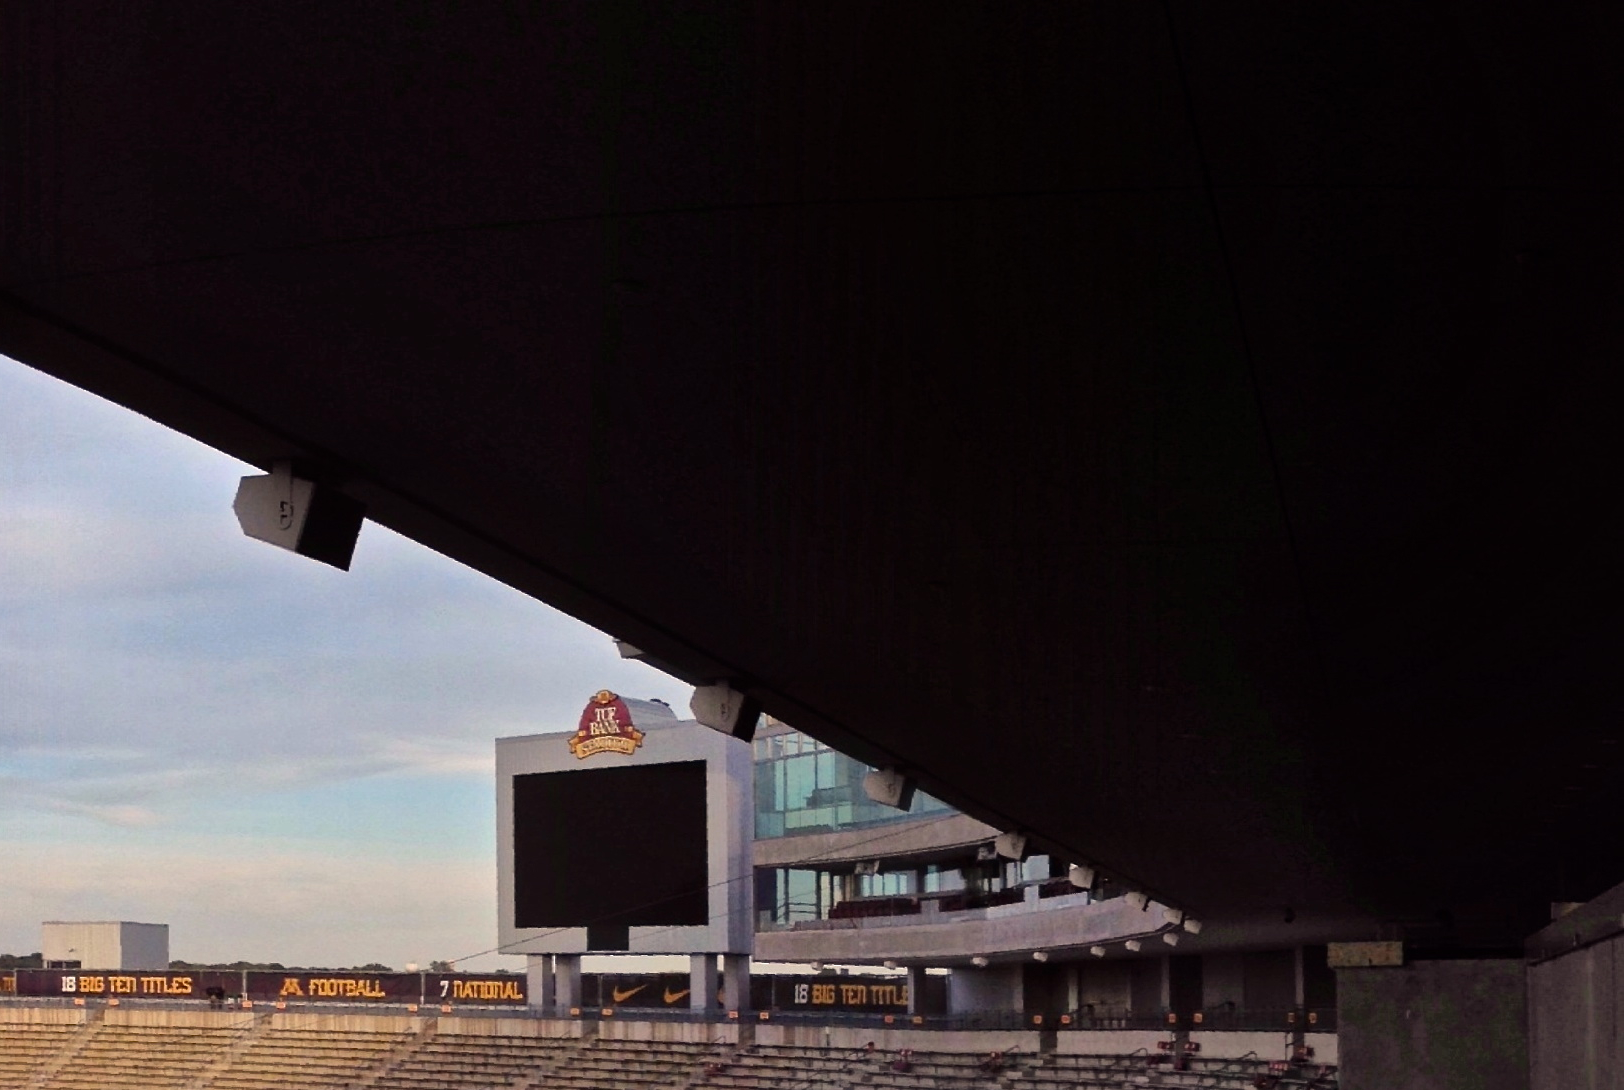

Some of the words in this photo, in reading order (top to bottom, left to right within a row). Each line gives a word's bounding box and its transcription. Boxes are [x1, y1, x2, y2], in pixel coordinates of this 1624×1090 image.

[79, 977, 104, 993] BIG
[141, 977, 192, 993] TITLES
[309, 979, 385, 997] FOOTBALL
[440, 981, 449, 998] 7
[454, 981, 523, 998] NATIONAL
[812, 984, 835, 1004] BIG
